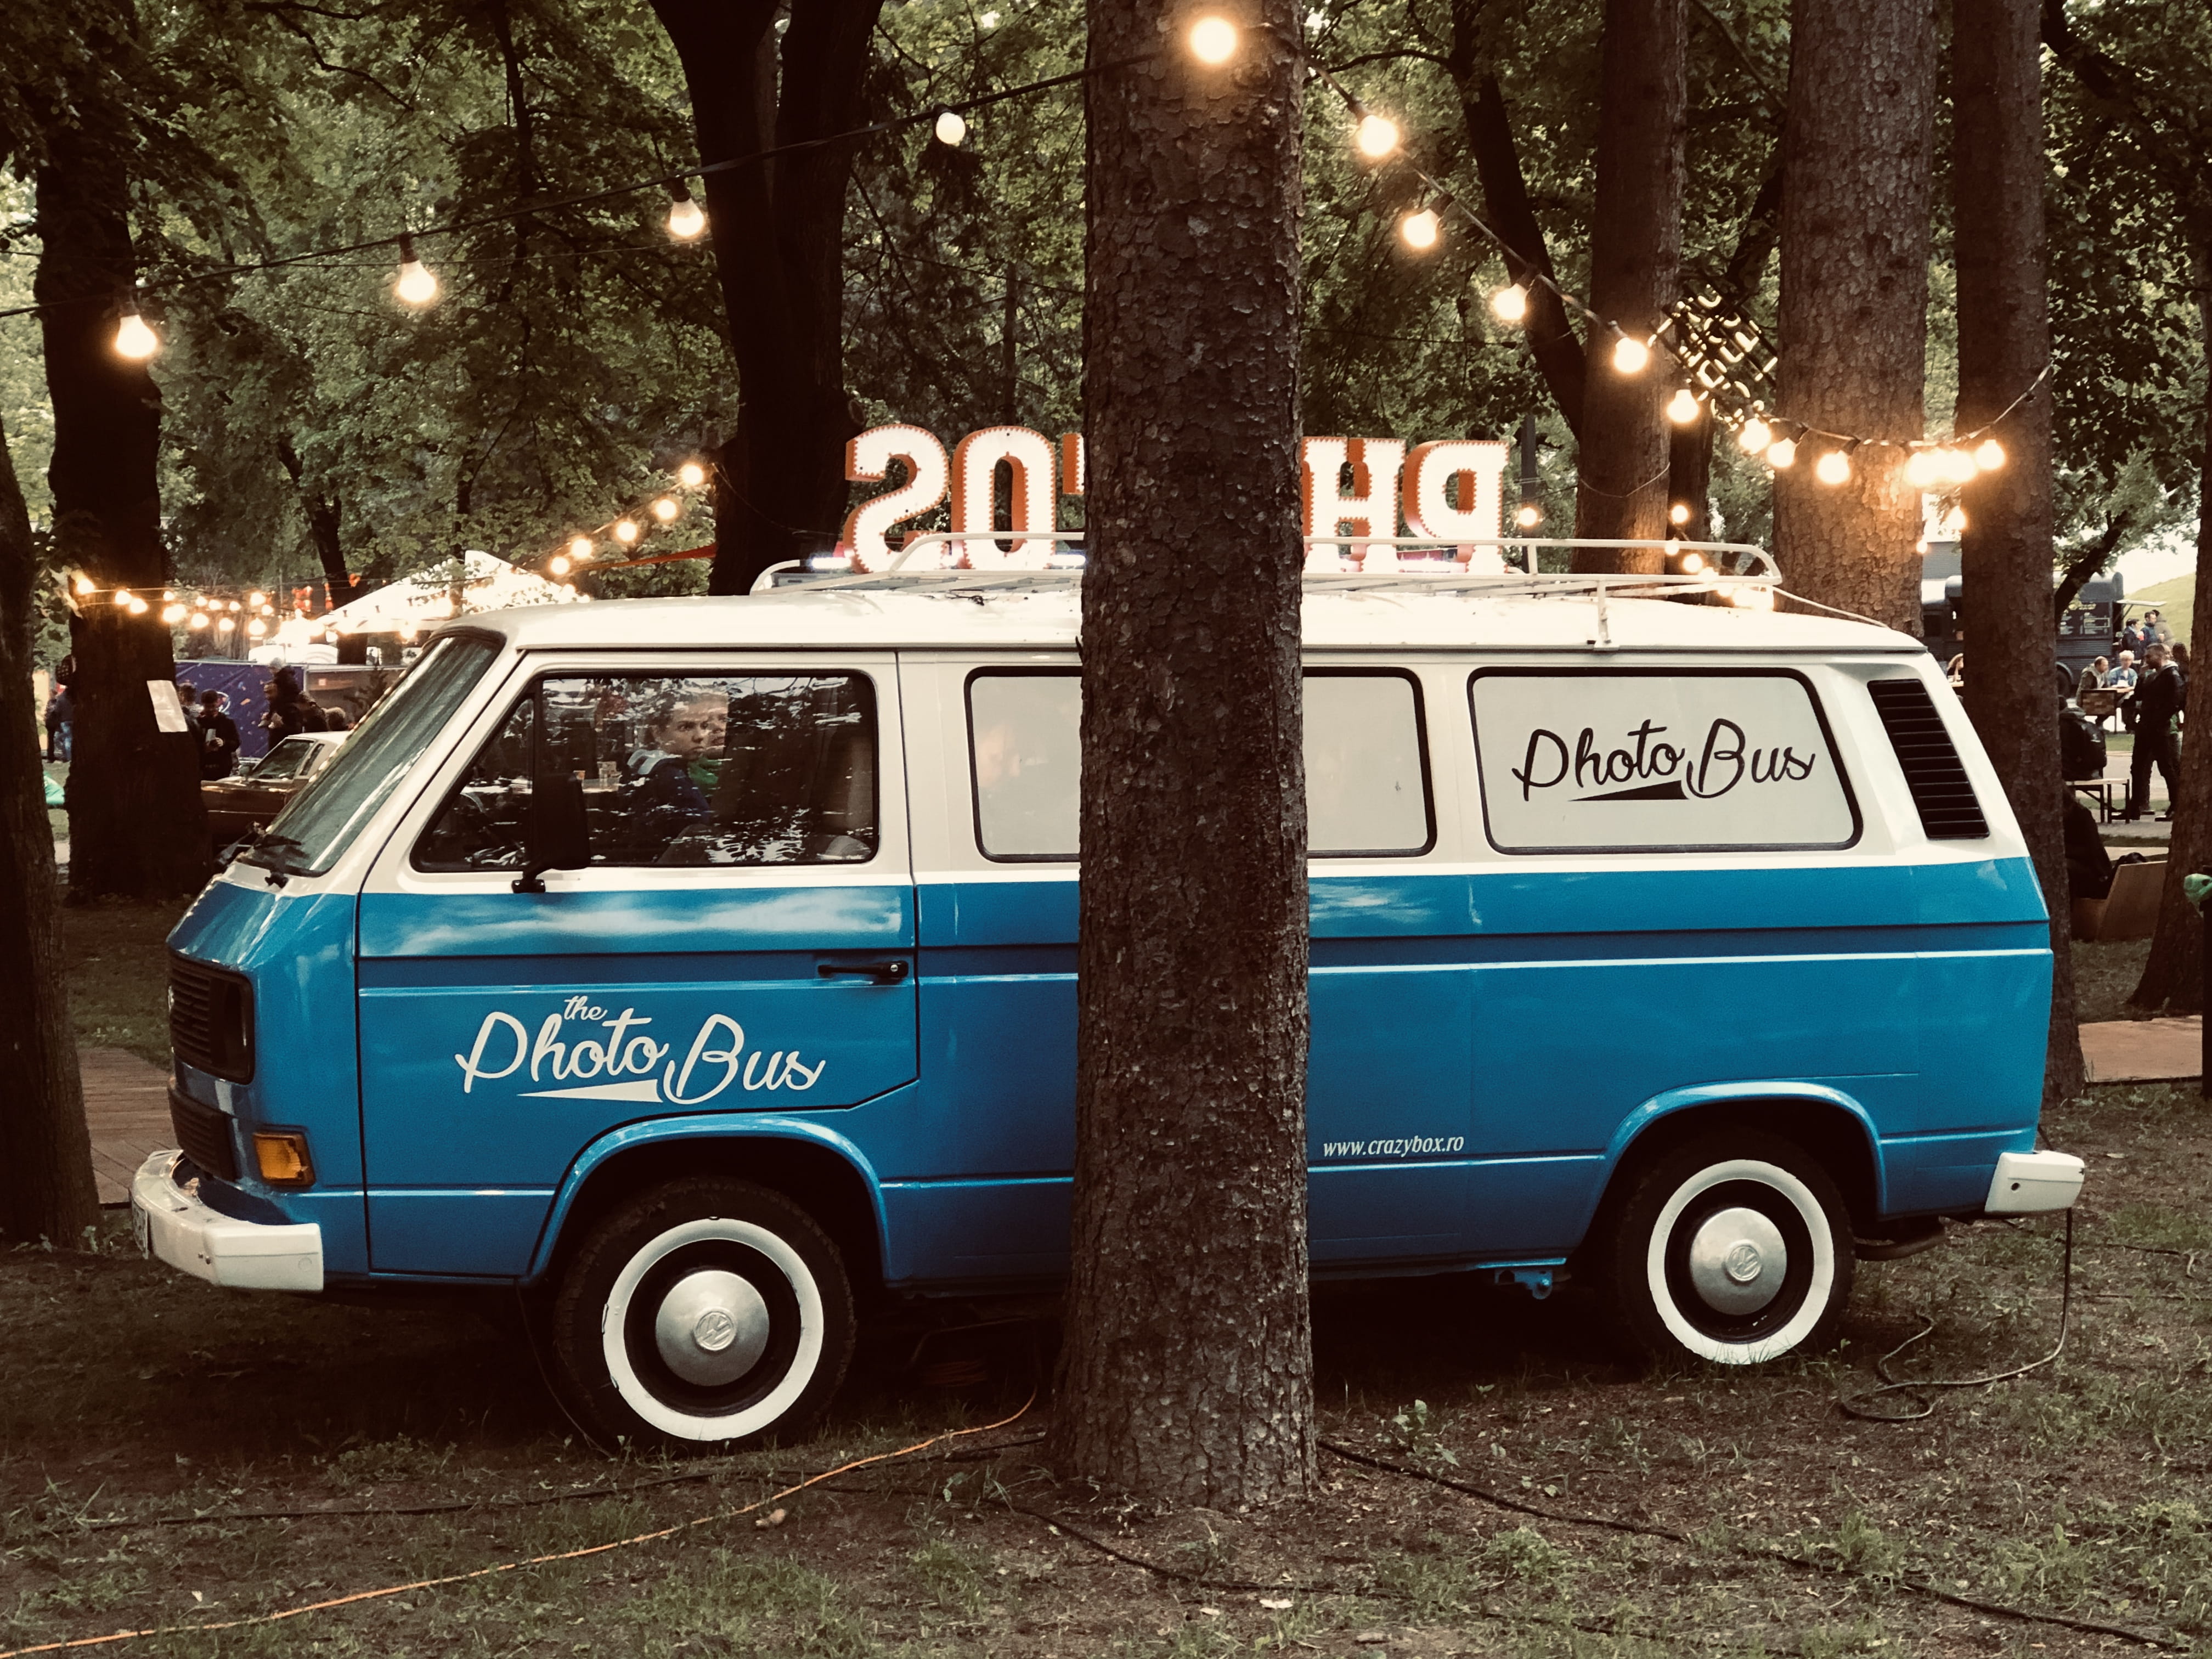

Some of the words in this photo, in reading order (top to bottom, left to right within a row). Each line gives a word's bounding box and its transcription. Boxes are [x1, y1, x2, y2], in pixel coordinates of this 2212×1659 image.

[1511, 719, 1685, 802] Photo
[1686, 718, 1816, 799] Bus
[563, 995, 608, 1020] the
[454, 1008, 670, 1093] Photo
[663, 1013, 826, 1105] Bus
[1323, 1135, 1465, 1158] www.crazybox.ro
